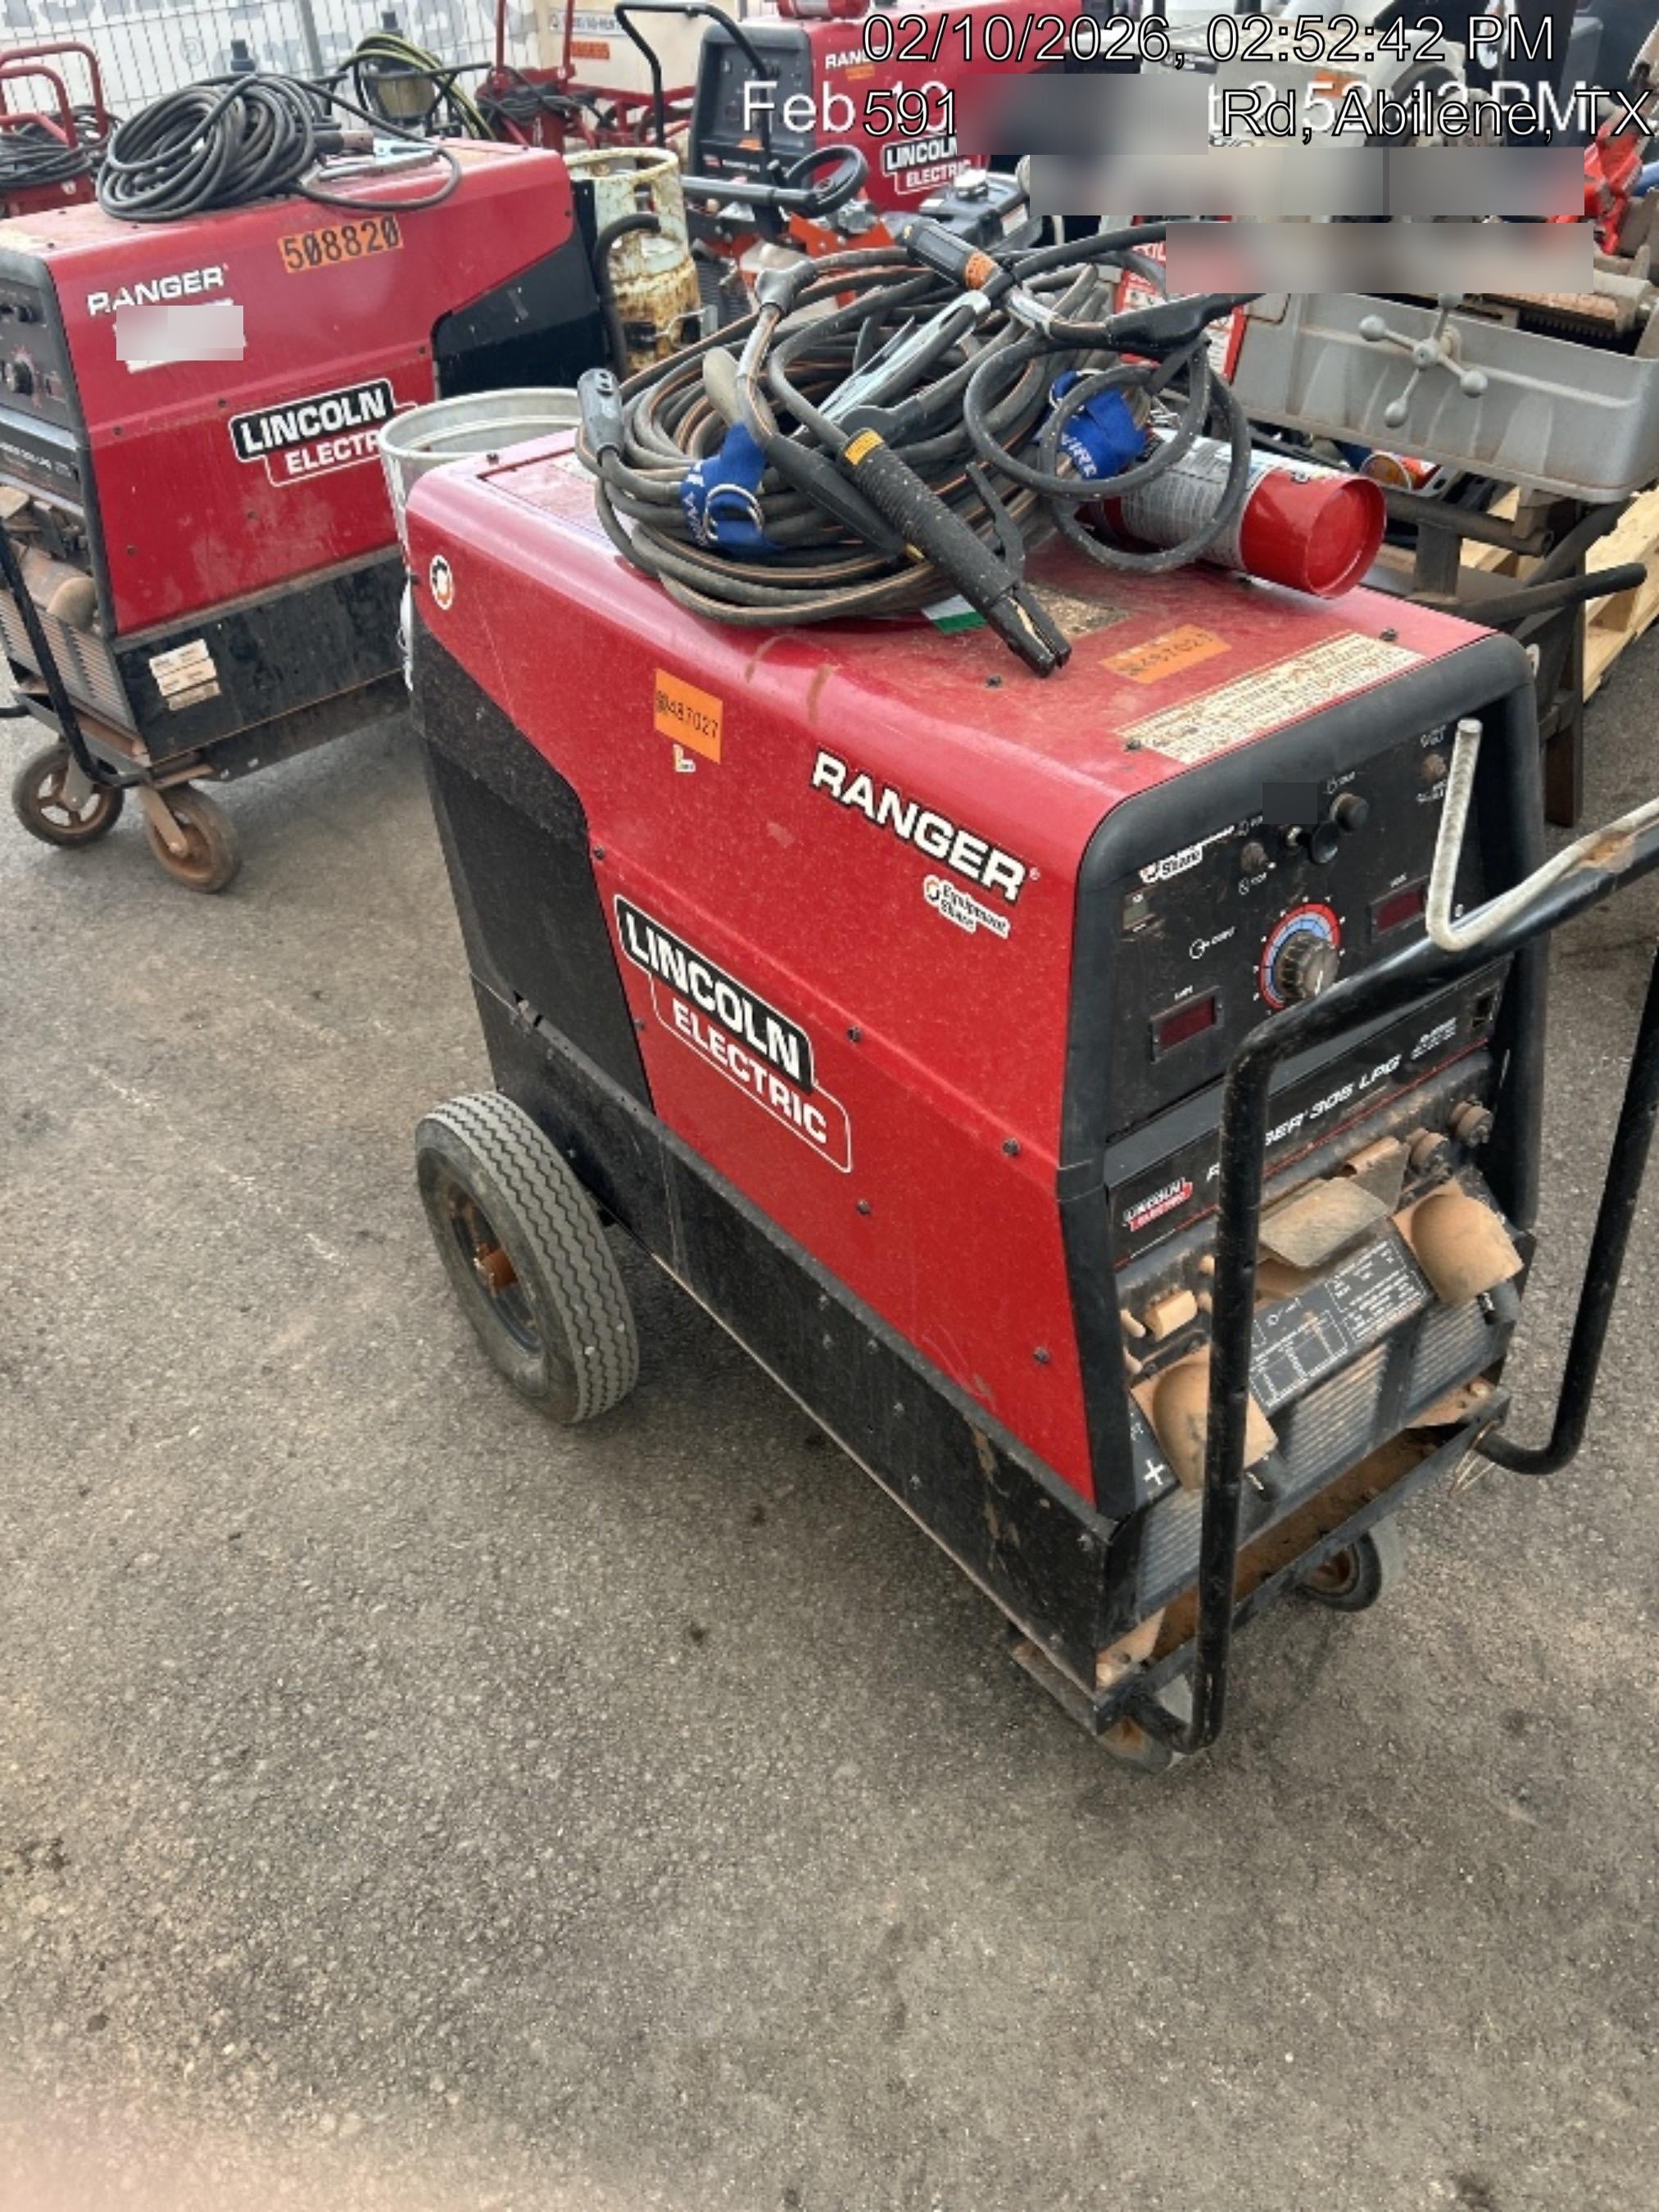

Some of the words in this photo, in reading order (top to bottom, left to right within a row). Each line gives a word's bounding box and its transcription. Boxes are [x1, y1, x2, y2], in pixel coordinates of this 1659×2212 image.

[283, 215, 401, 270] 508820
[241, 388, 387, 454] LINCOLN
[625, 912, 801, 1082] LINCOLN
[672, 997, 827, 1145] ELECTRIC
